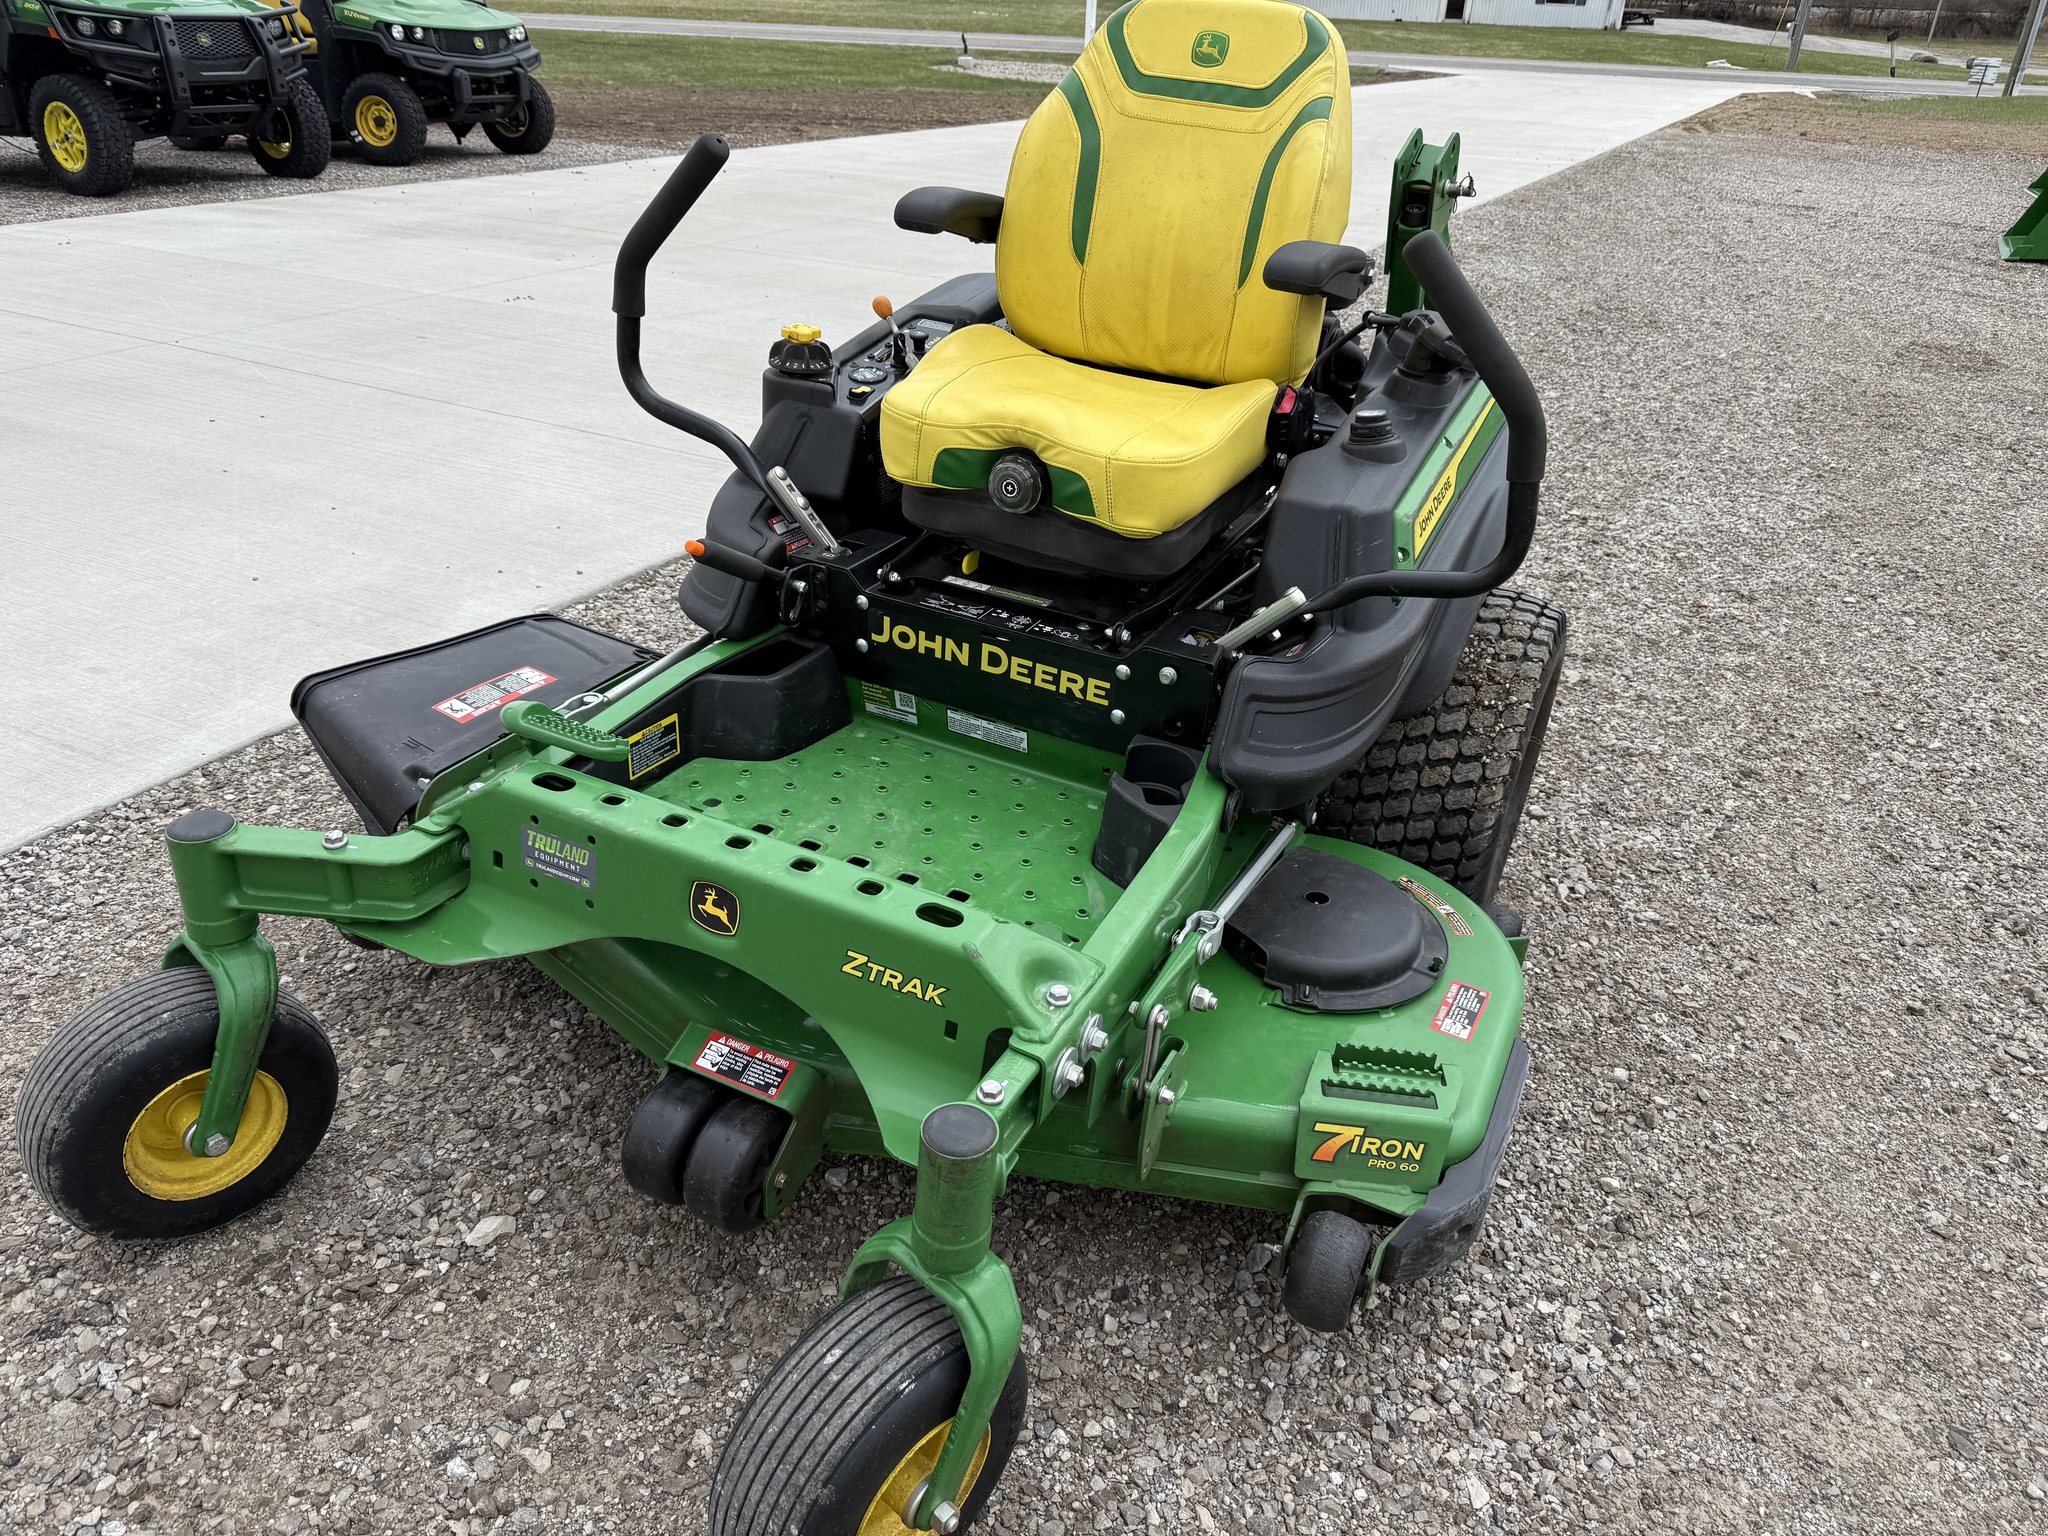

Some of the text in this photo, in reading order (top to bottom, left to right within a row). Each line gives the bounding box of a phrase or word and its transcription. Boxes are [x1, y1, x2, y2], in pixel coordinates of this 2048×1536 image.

[1419, 475, 1452, 538] JOHN DEERE
[871, 616, 1111, 706] JOHN DEERE
[527, 829, 590, 867] TRULAND
[534, 850, 581, 873] EQUIPMENT
[535, 862, 580, 883] TRULANDEQUIP.COM
[841, 949, 950, 1008] ZTRAK
[726, 1039, 750, 1052] DANGER
[764, 1053, 789, 1067] PELIGRO
[1367, 1158, 1419, 1172] PRO 60
